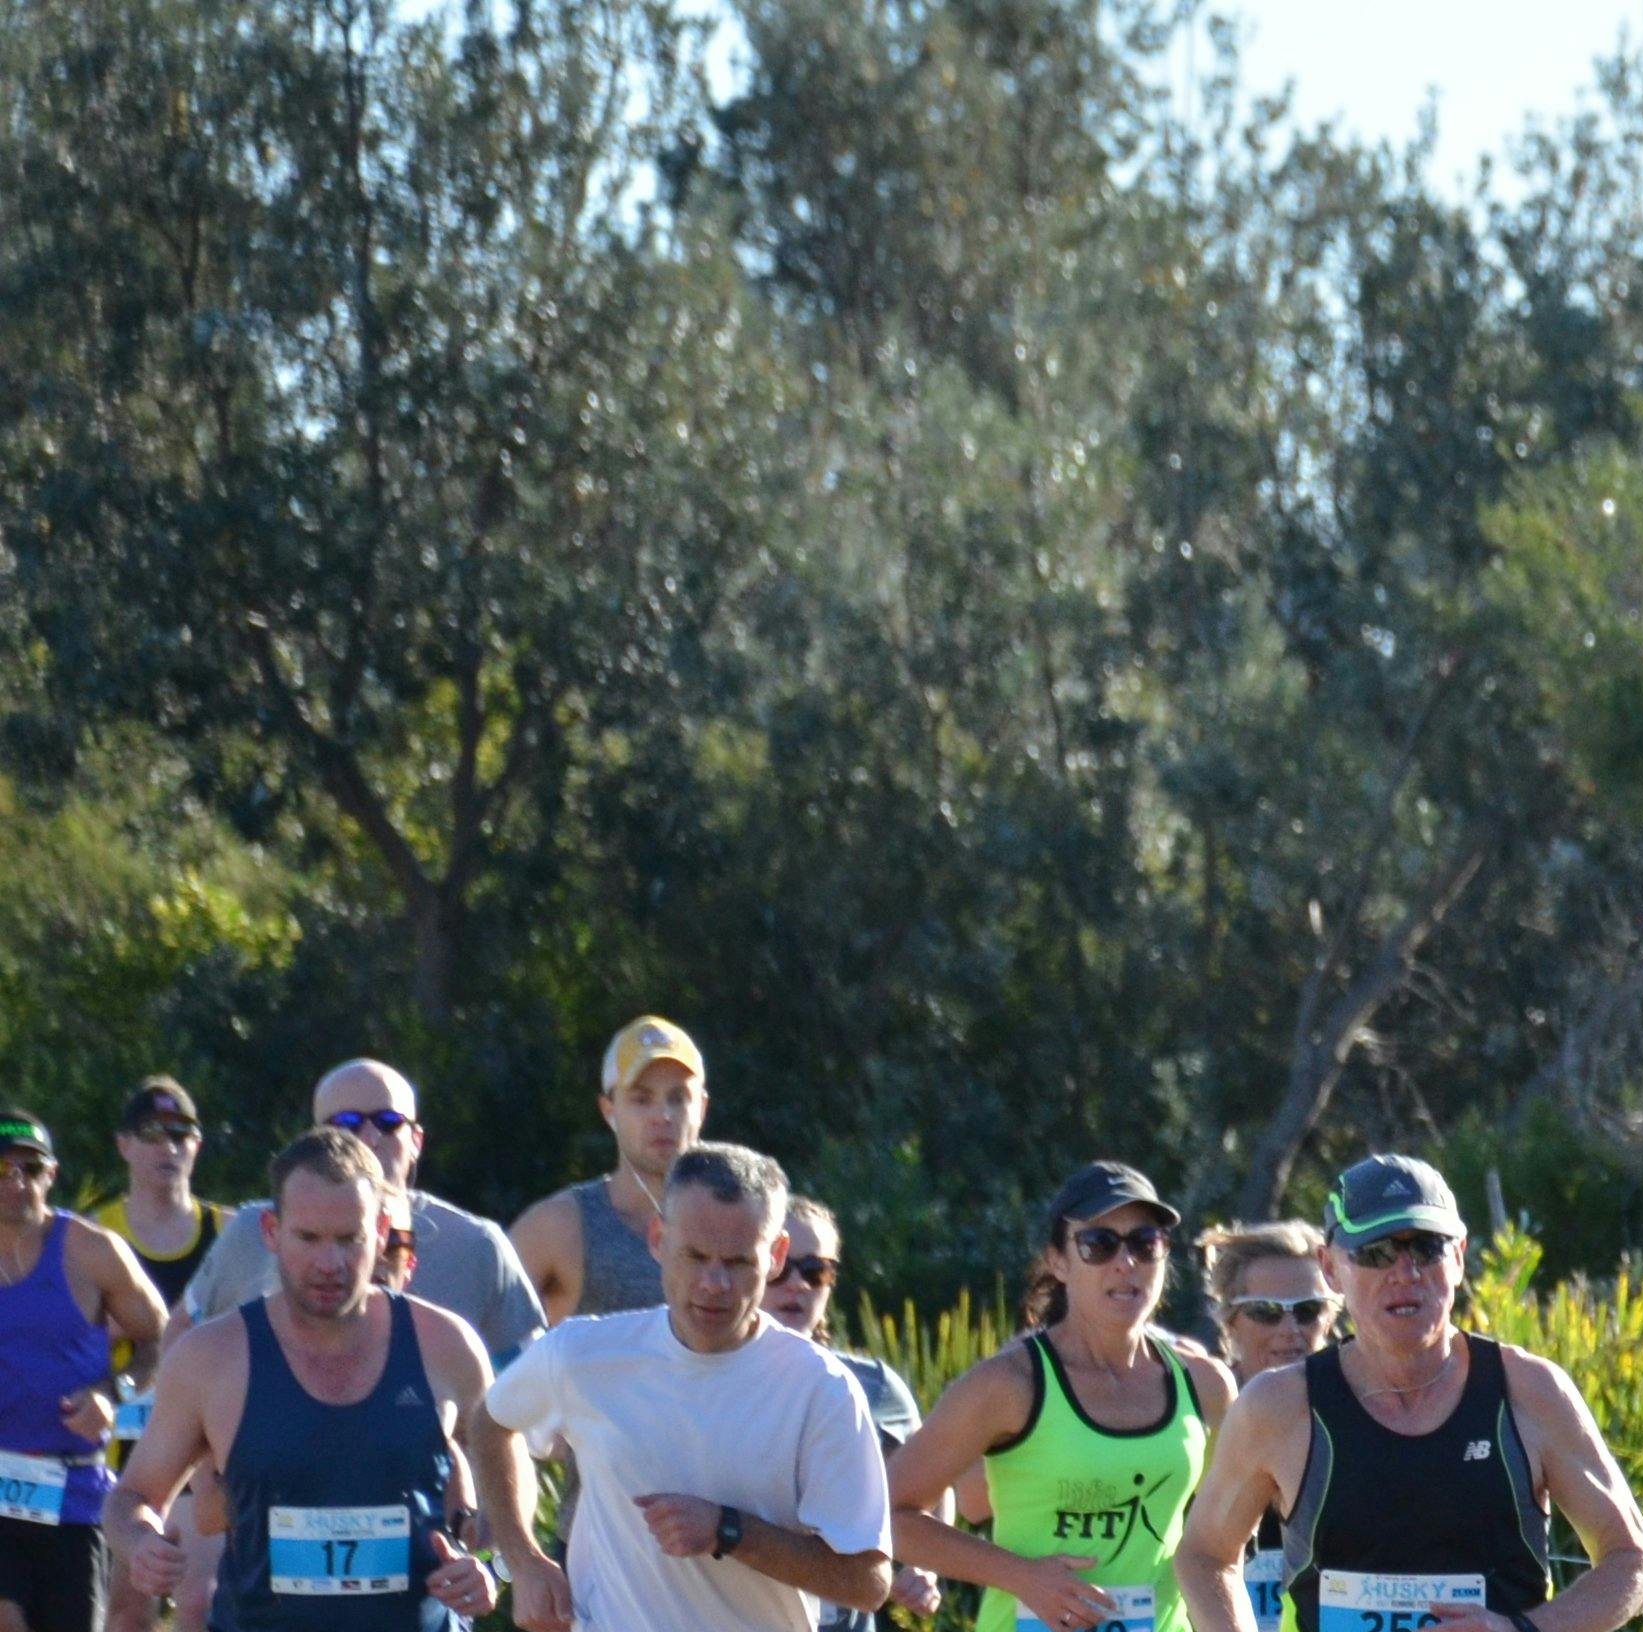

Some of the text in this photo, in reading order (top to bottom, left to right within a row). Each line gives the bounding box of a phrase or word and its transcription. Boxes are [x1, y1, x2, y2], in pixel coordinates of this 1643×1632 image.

[0, 1476, 37, 1505] 07
[1054, 1511, 1124, 1539] FIT
[322, 1540, 358, 1576] 17
[1373, 1581, 1446, 1599] HUSKY
